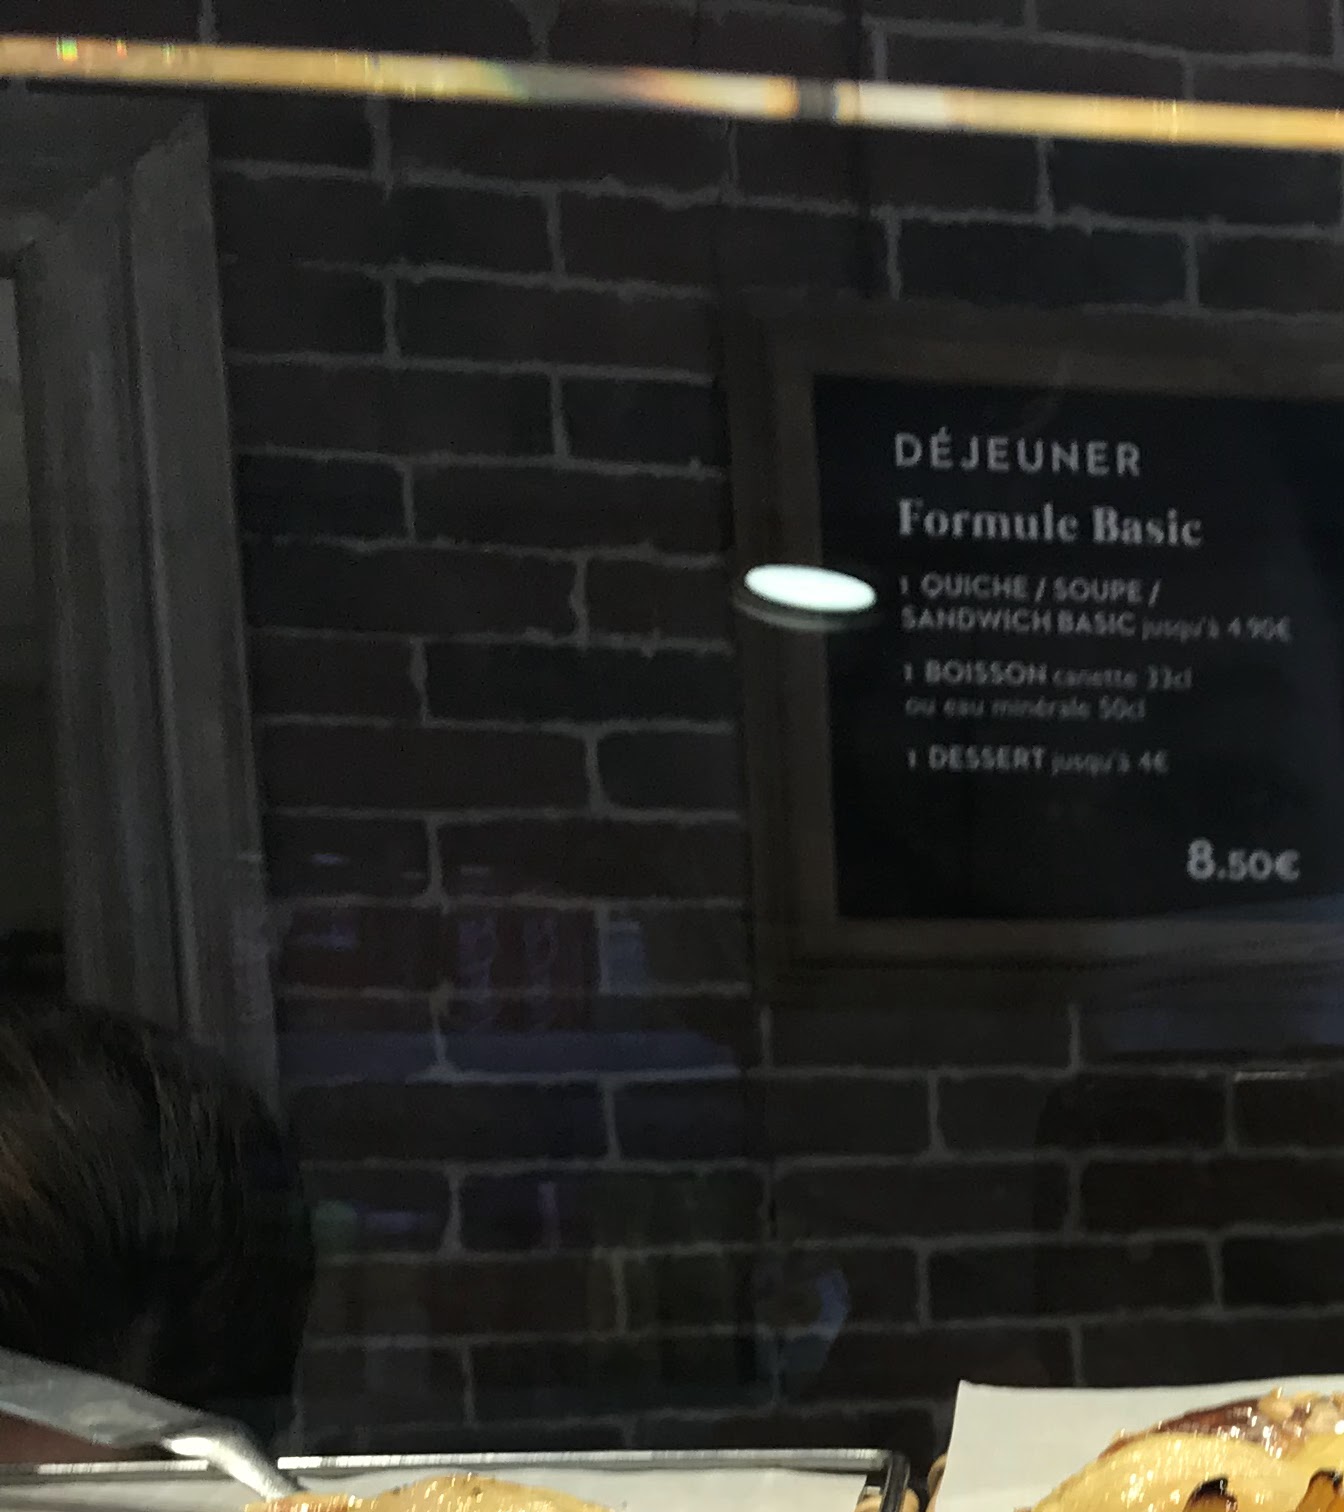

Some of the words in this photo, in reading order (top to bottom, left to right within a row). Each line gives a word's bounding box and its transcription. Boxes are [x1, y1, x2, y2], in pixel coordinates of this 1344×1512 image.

[895, 426, 1142, 477] DÉJEUNER
[898, 498, 1080, 542] Formule
[1092, 504, 1204, 547] Basic
[920, 570, 1028, 600] QUICHE
[1053, 576, 1142, 604] SOUPE
[900, 605, 1052, 636] SANDWICH
[1057, 609, 1136, 638] BASIC
[925, 659, 1048, 688] BOISSON
[928, 745, 1046, 772] DESSERT
[1187, 837, 1301, 882] 8.50€
